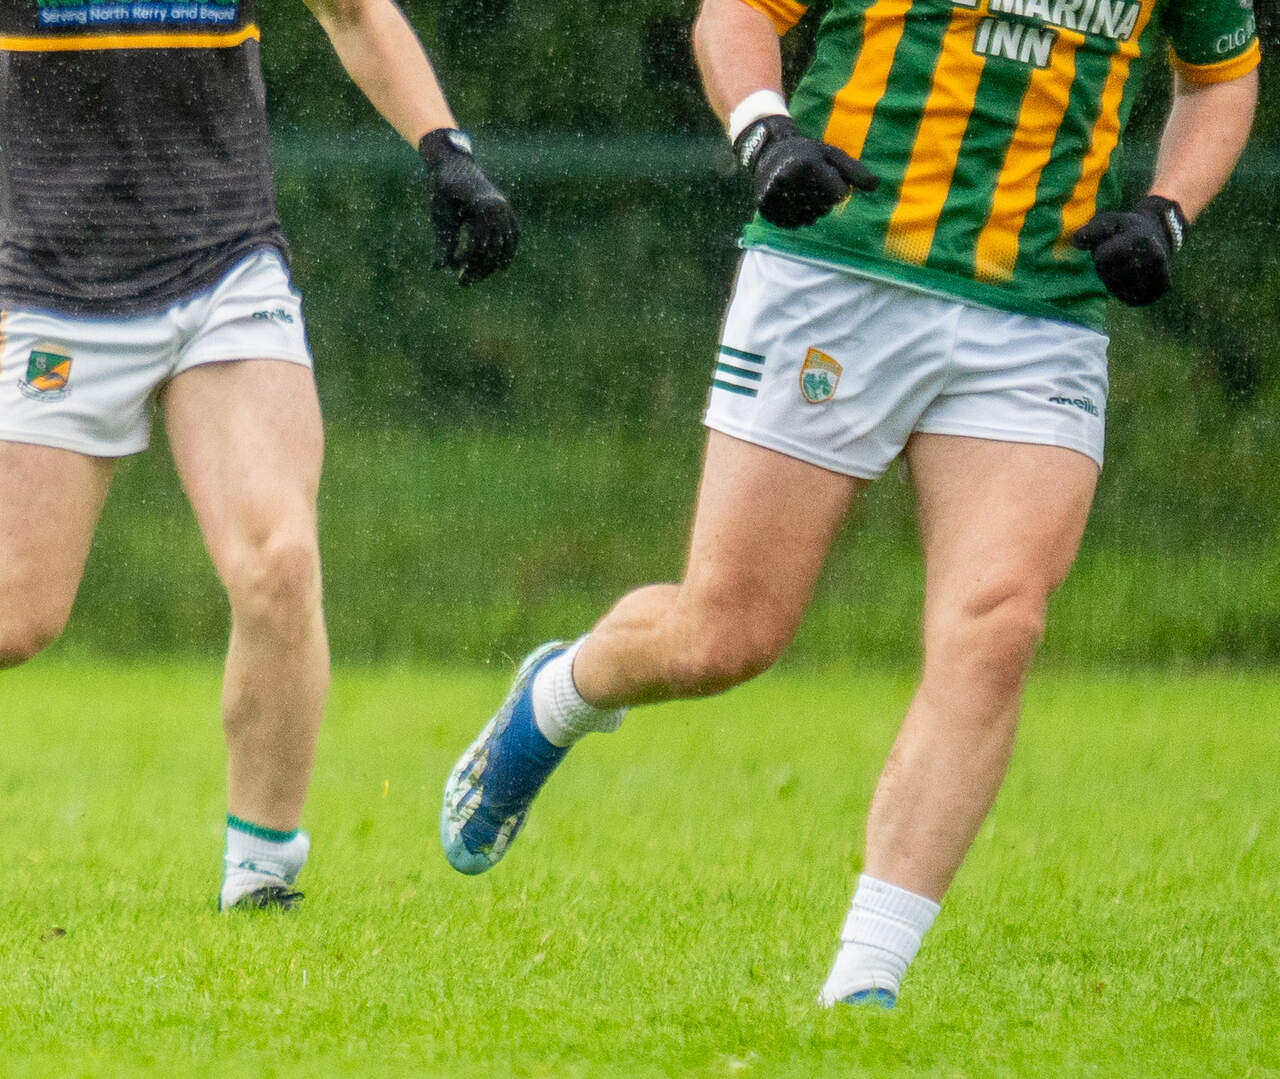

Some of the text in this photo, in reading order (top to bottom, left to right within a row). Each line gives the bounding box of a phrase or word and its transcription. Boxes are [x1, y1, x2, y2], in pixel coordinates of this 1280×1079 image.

[90, 5, 129, 21] North
[132, 4, 167, 22] Kerry
[170, 4, 198, 20] and
[974, 18, 1055, 68] INN
